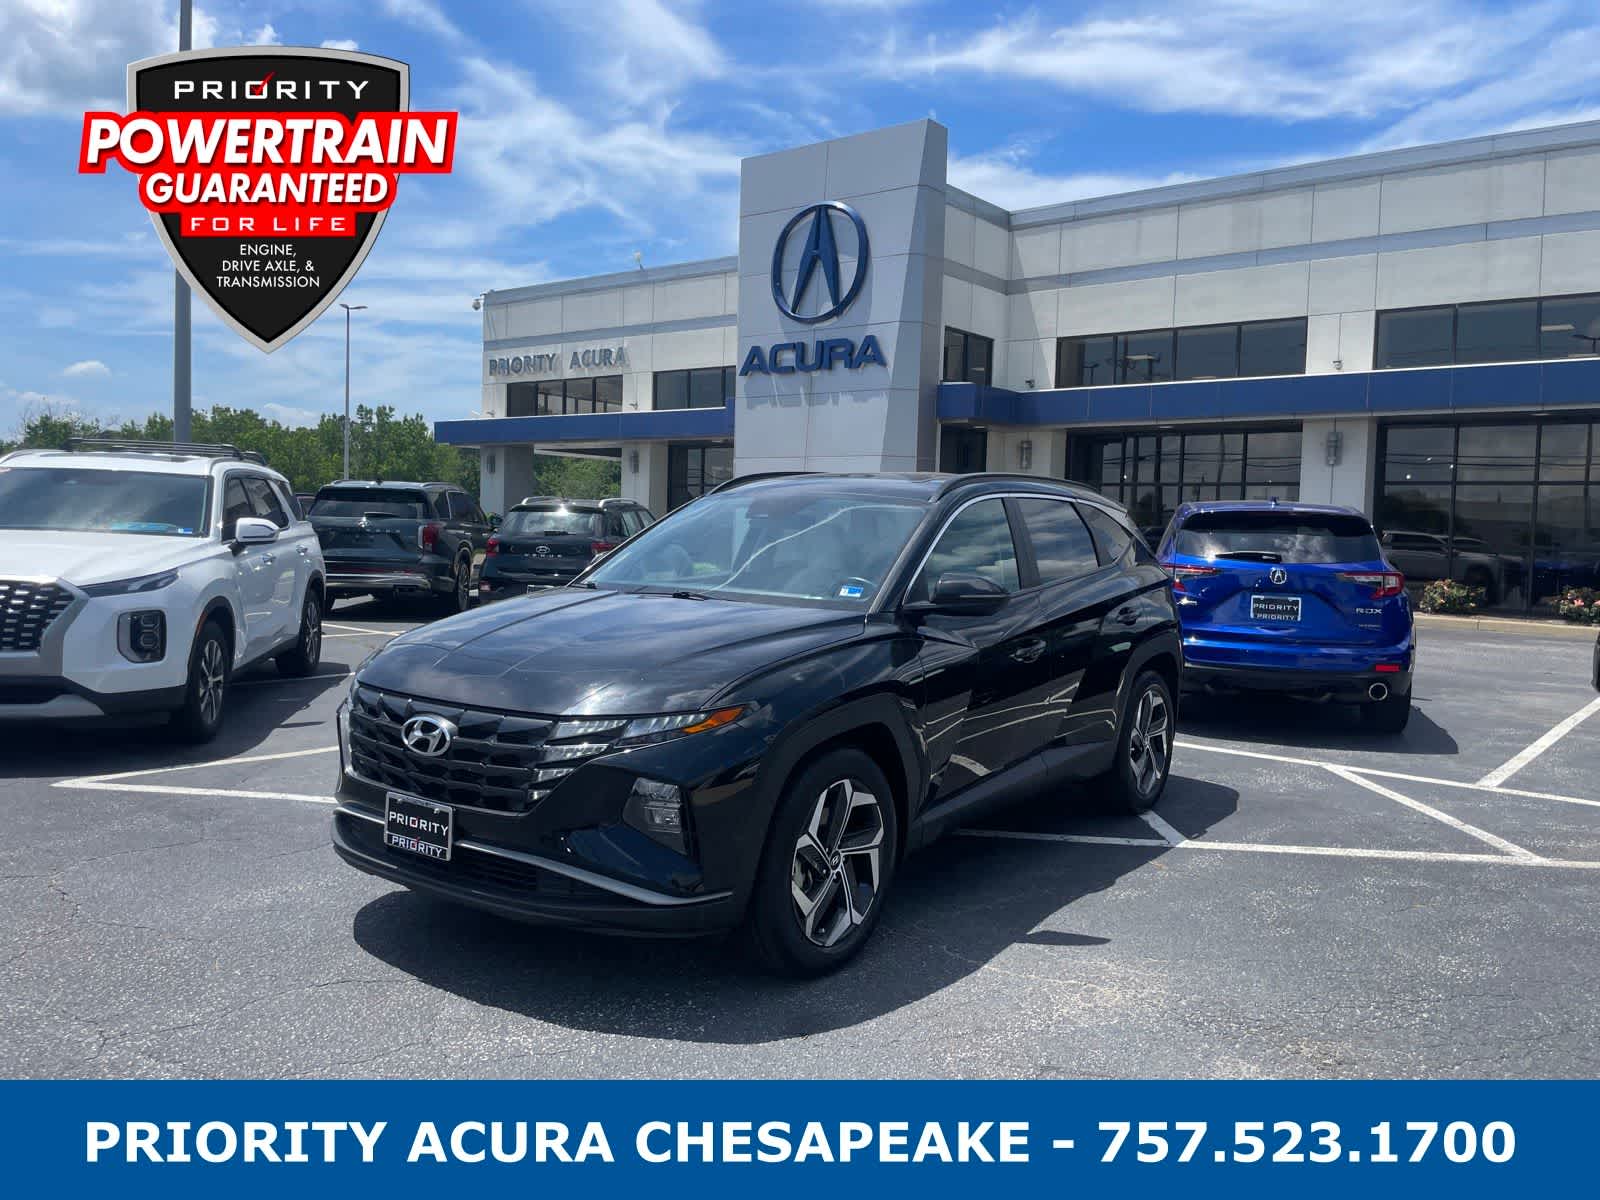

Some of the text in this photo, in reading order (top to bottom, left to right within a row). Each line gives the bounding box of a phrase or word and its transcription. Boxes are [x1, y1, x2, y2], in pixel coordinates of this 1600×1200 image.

[488, 346, 629, 376] PRIORITY ACURA
[739, 335, 888, 377] ACURA
[1253, 603, 1299, 611] PRIORITY
[1256, 613, 1296, 621] PRIORITY
[388, 811, 449, 837] PRIORITY
[391, 836, 443, 857] PRIORITY
